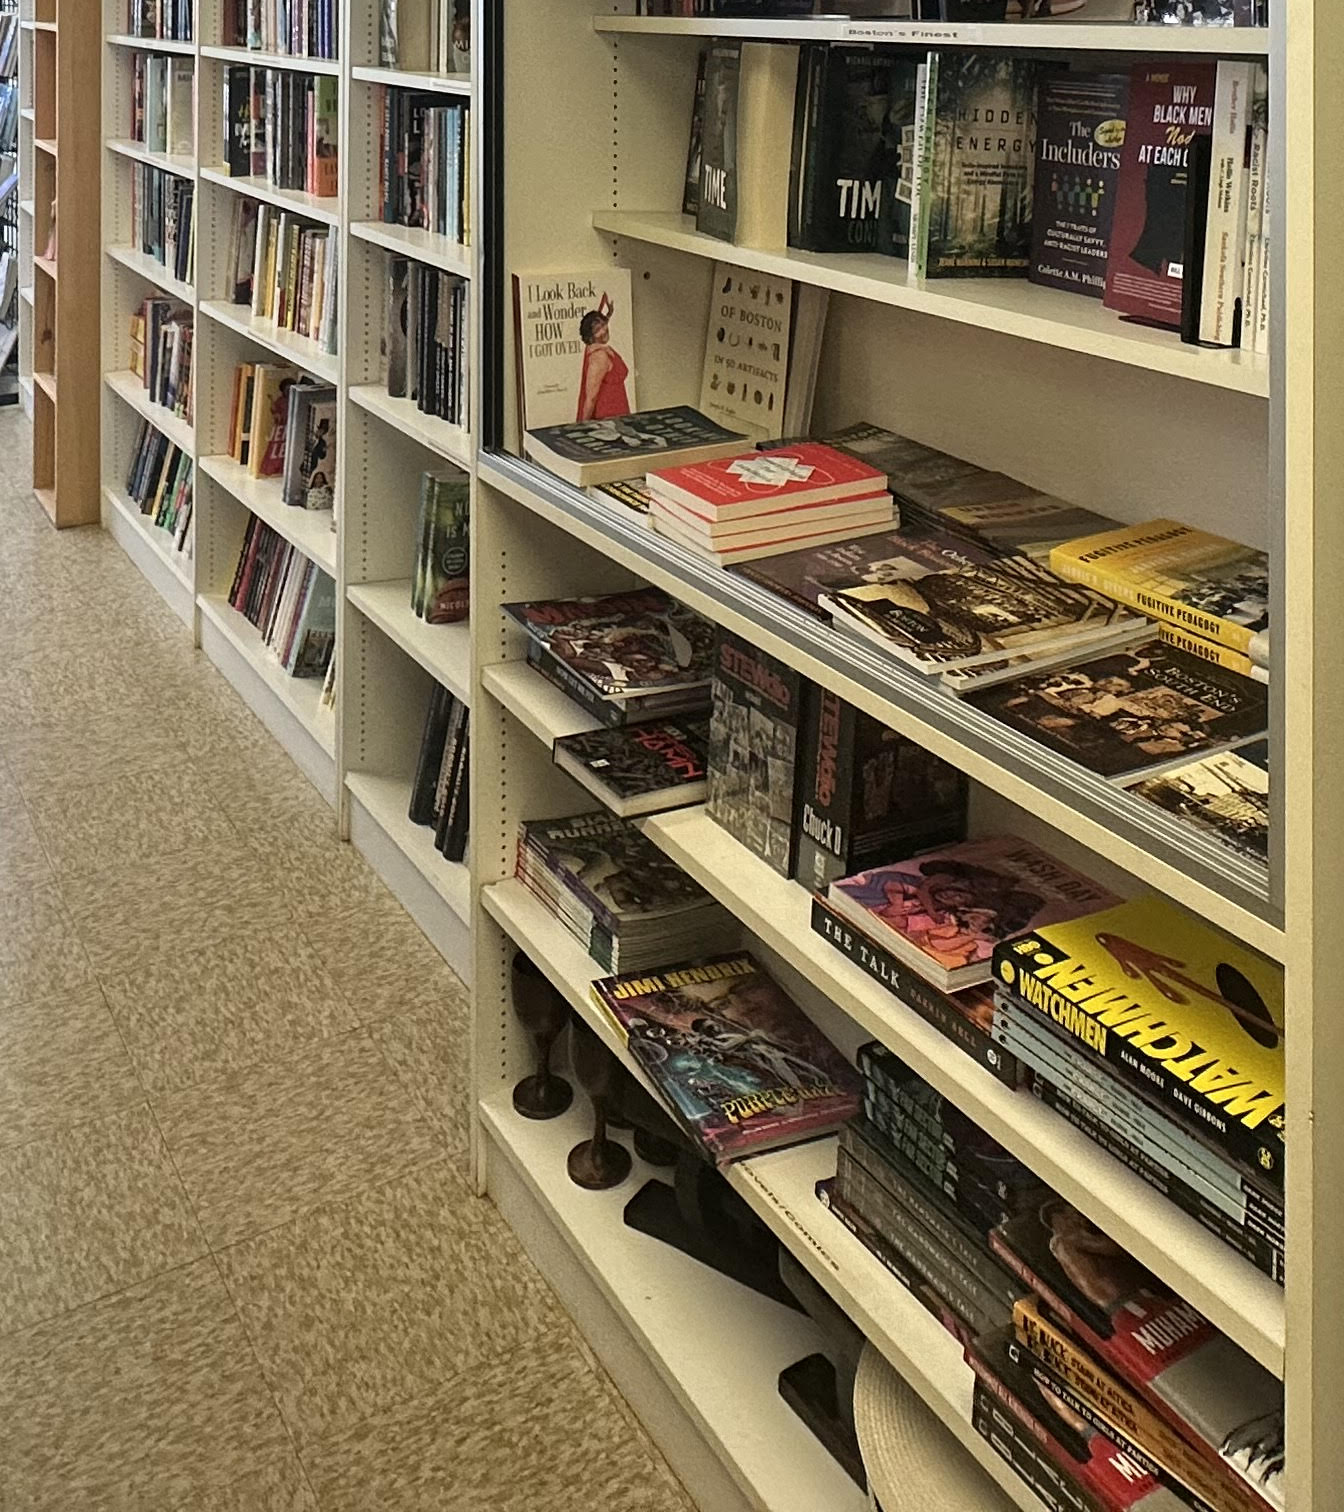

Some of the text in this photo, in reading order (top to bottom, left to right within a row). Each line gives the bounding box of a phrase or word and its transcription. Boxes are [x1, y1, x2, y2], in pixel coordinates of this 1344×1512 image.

[848, 28, 959, 39] Boston's Finest
[1172, 86, 1197, 104] WHY
[1069, 121, 1091, 138] The
[1153, 105, 1212, 127] BLACK MEN
[956, 136, 1038, 153] ENERGY
[1165, 125, 1195, 146] Nod
[1041, 138, 1121, 170] Includers
[1138, 145, 1182, 166] AT EACH
[1252, 144, 1261, 178] Racist
[704, 163, 727, 211] TIME
[836, 178, 883, 220] TIM
[1038, 264, 1064, 279] Colette
[528, 279, 597, 303] I Look Back
[527, 302, 588, 321] and Wonder
[721, 304, 782, 333] OF BOSTON
[535, 322, 564, 342] HOW
[529, 340, 582, 359] I GOT OVER
[713, 355, 779, 384] IN 50 ARTIFACTS
[1079, 526, 1193, 564] FUGITIVE PEDAGOGY
[1137, 592, 1221, 635] FUGITIVE PEDAGOGY
[1177, 634, 1221, 663] PEDAGOGY
[1145, 669, 1237, 713] SOUTH END
[1164, 667, 1242, 704] BOSTON'S
[802, 803, 842, 856] Chuck D
[1056, 880, 1102, 902] DAY
[824, 917, 853, 951] THE
[860, 945, 900, 989] TALK
[613, 957, 756, 1000] JIMI HENDRIX
[1018, 967, 1227, 1134] WATCHMEN ALAN MOORE DAVE GIBBONS
[1034, 961, 1284, 1132] WATCHMEN
[721, 1087, 799, 1124] PURPLE
[1131, 1302, 1207, 1356] MUHAM
